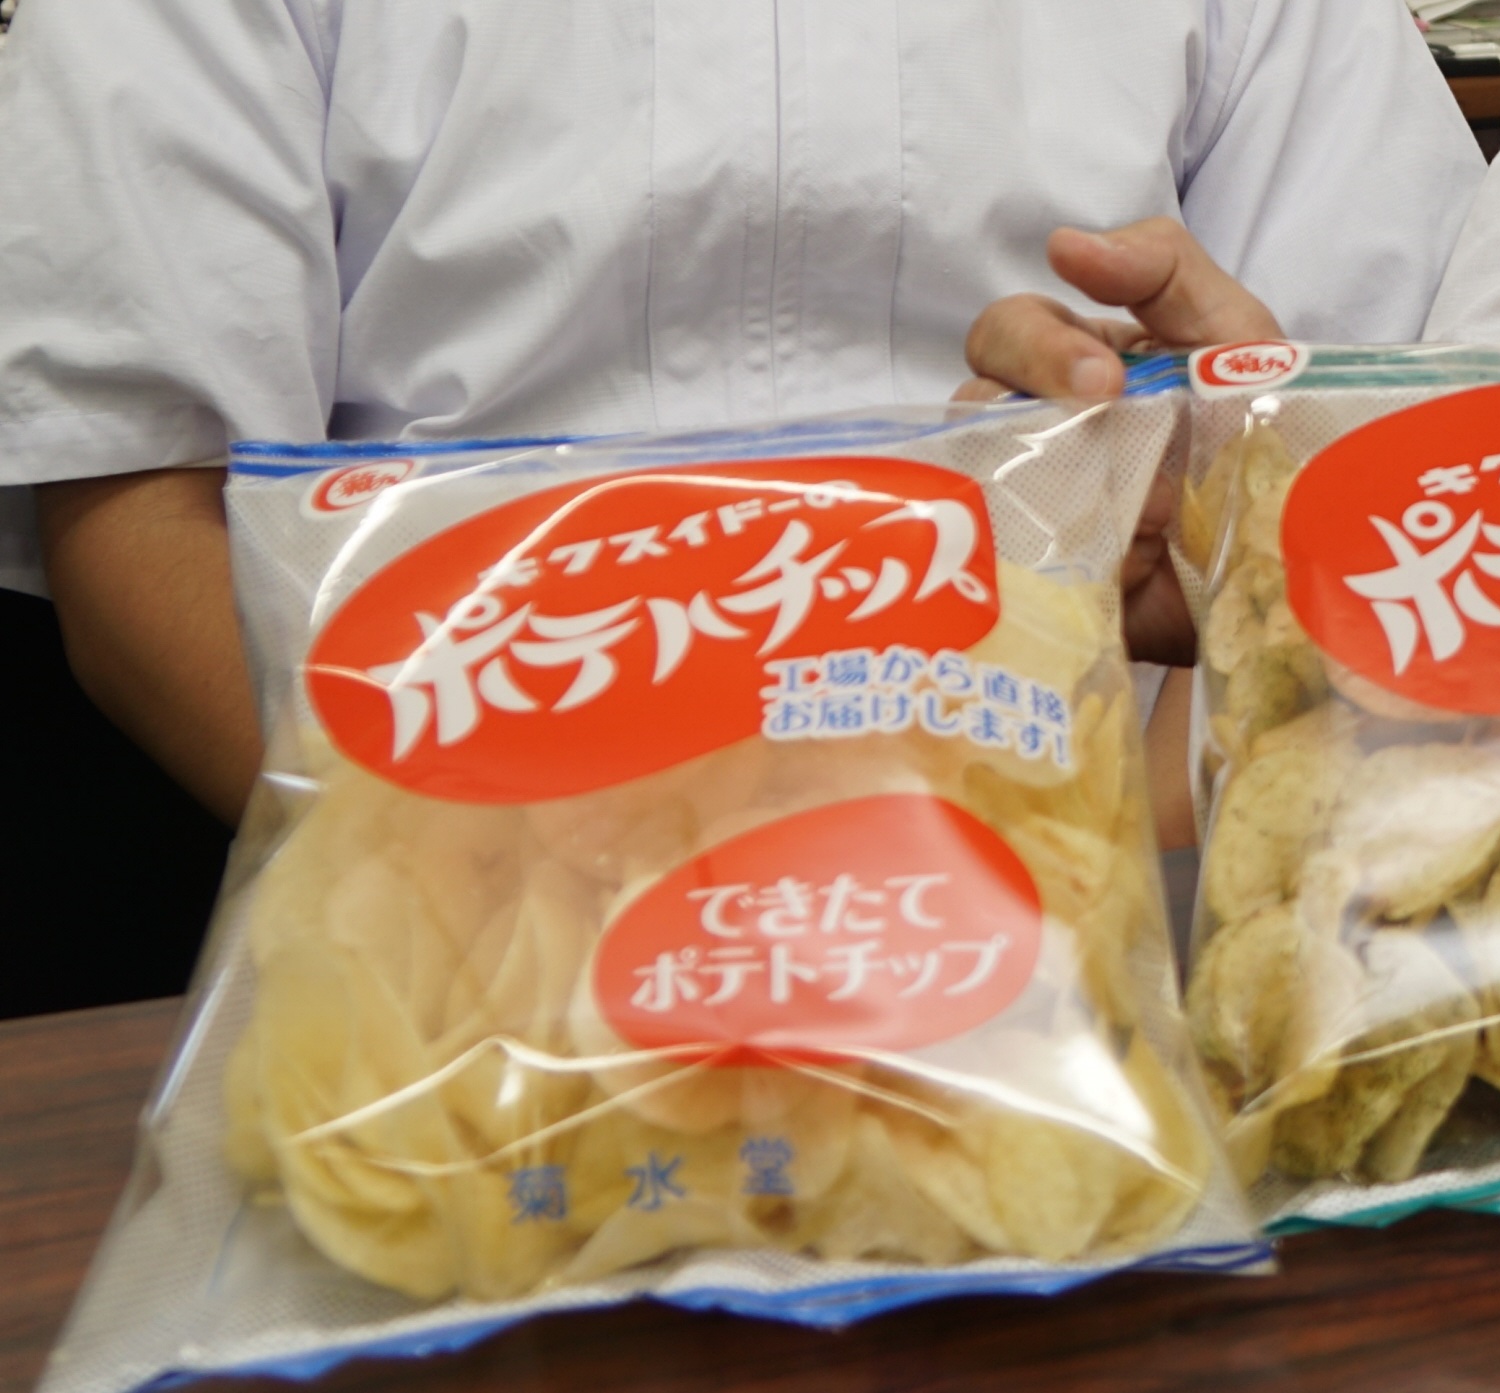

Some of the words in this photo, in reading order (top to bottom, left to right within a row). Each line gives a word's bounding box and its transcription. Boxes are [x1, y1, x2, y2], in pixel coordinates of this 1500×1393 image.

[766, 651, 1067, 727] 工場から直接
[687, 874, 951, 935] できたて
[630, 934, 1009, 1011] ポテトチップ
[507, 1136, 797, 1225] 菊水堂
